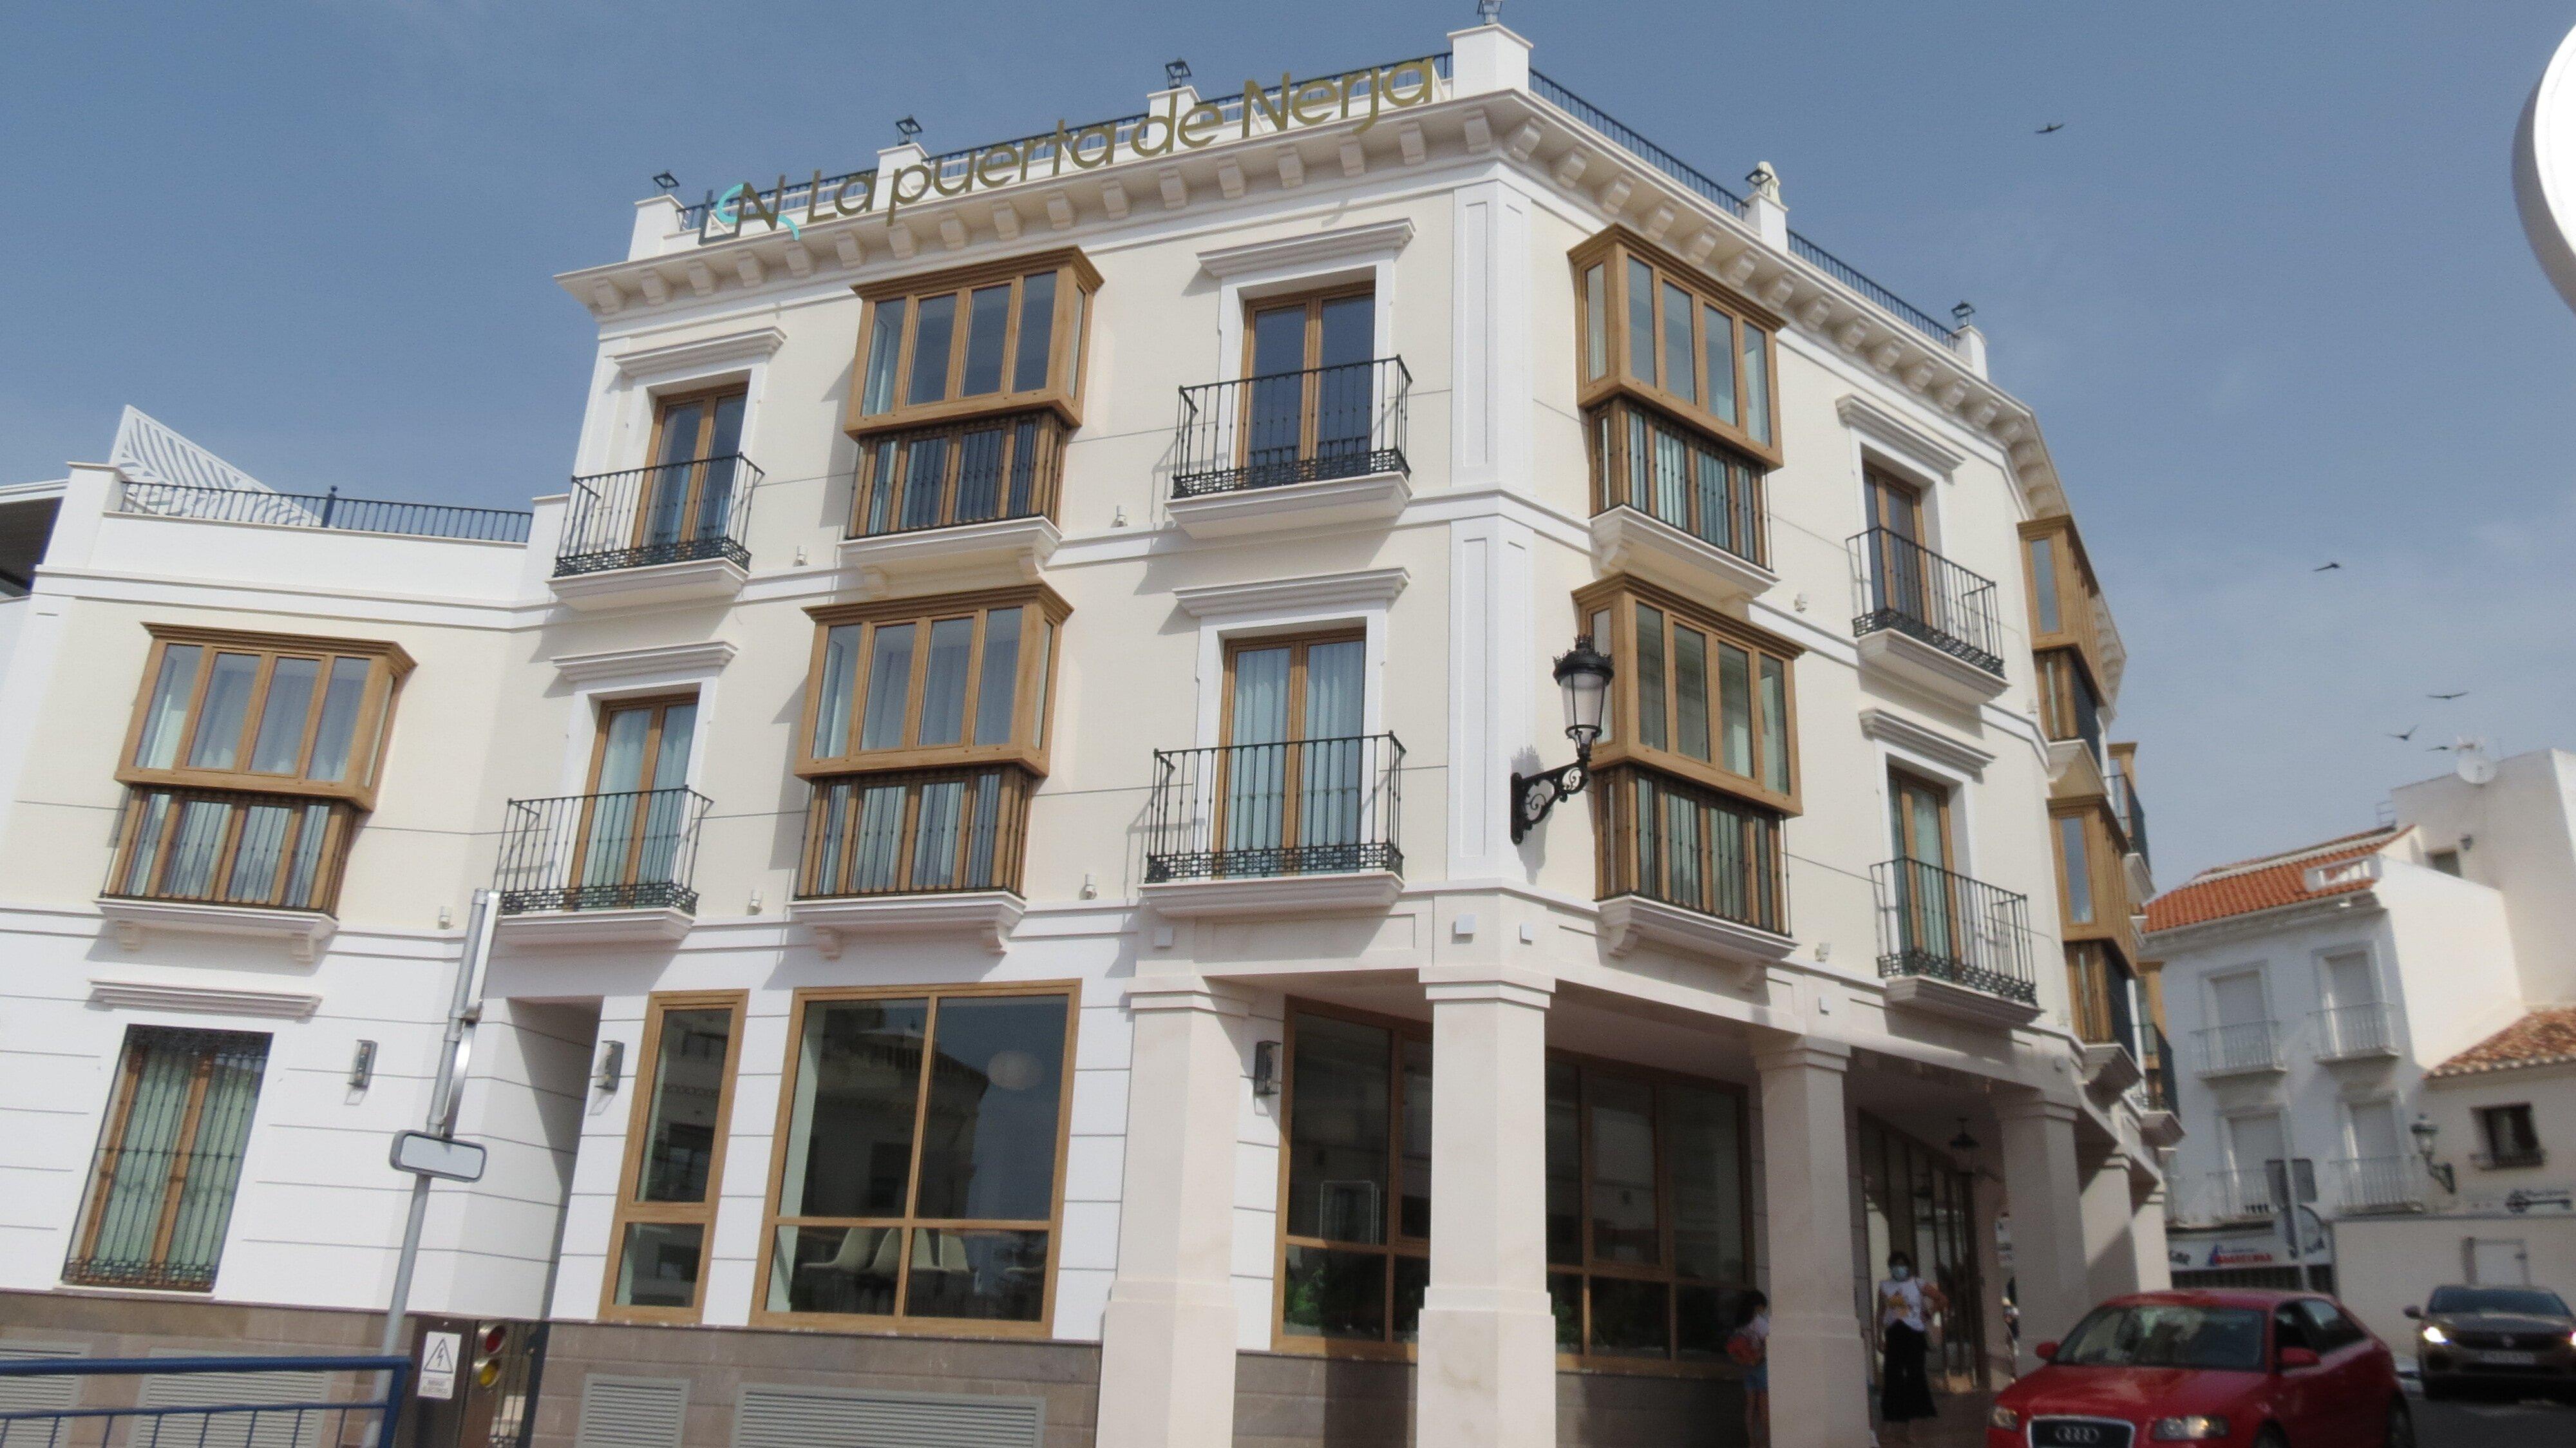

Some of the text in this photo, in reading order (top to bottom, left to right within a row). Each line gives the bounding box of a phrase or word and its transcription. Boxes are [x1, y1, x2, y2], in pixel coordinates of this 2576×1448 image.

[806, 169, 878, 224] La
[886, 119, 1117, 227] puerta
[1130, 91, 1224, 157] de
[1242, 57, 1434, 135] Nerja
